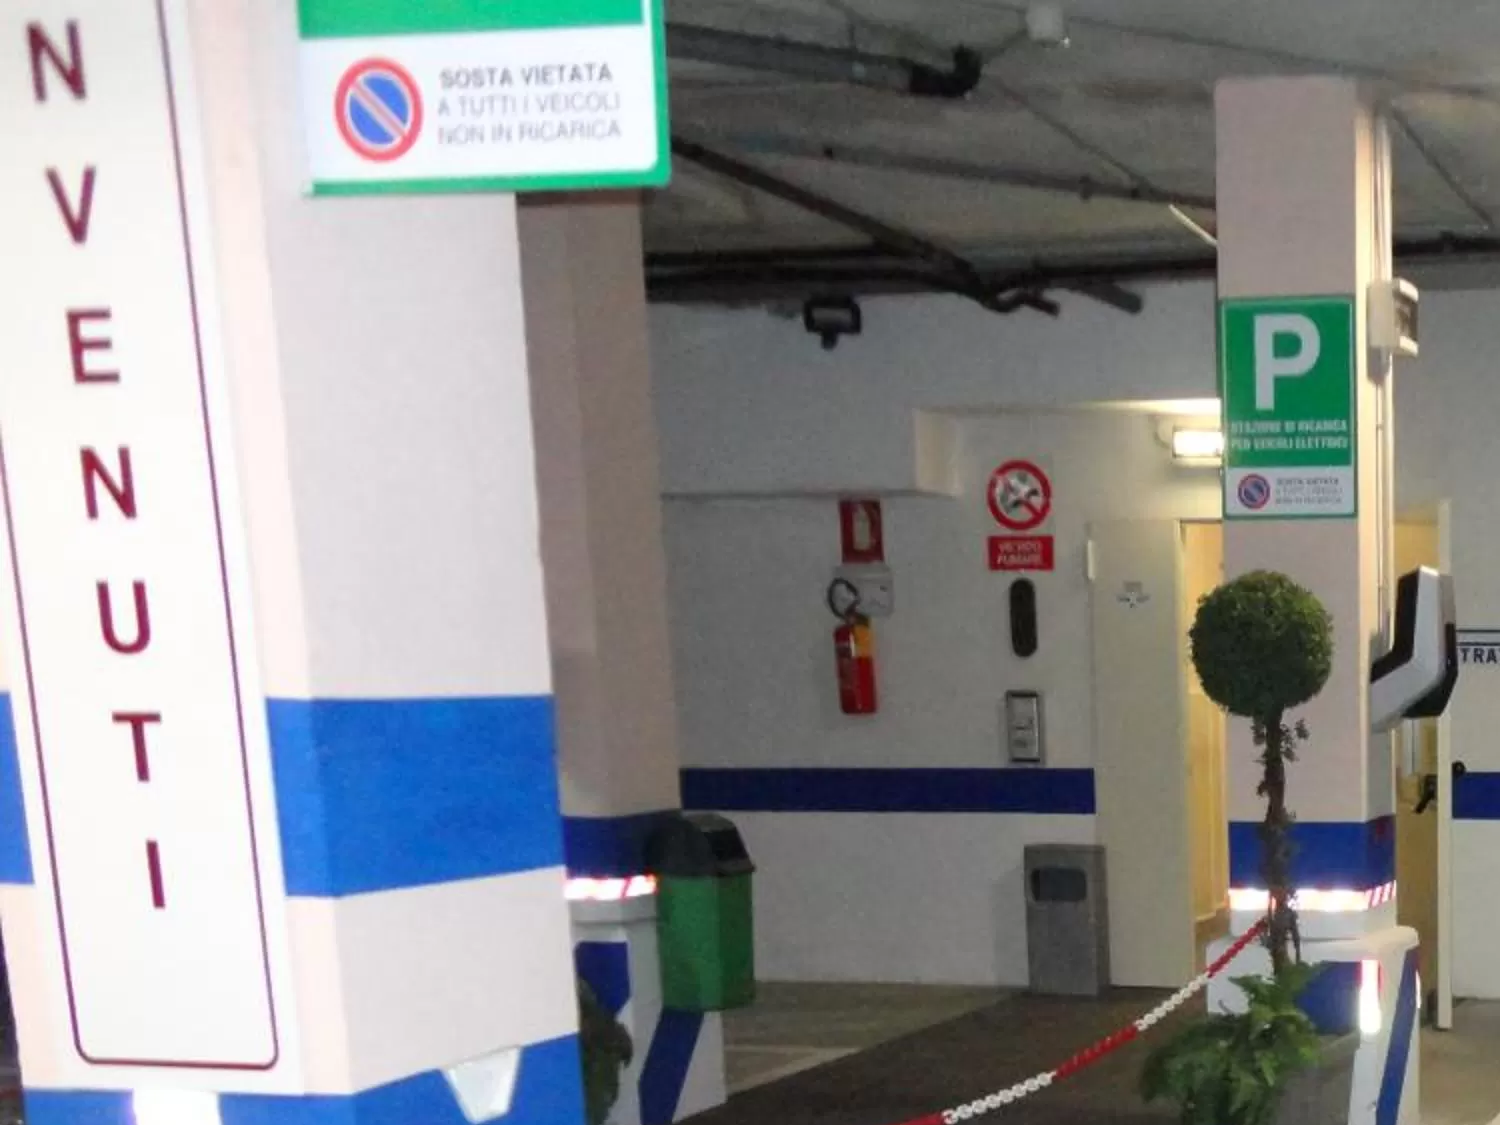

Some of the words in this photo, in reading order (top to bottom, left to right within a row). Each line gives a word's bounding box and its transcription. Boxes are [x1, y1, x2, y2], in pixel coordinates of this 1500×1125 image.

[438, 66, 514, 90] SOSTA
[519, 62, 614, 87] VIETATA
[437, 96, 450, 117] A
[457, 94, 517, 118] TUTTI
[534, 91, 621, 114] VEICOLI
[437, 123, 486, 145] NON
[490, 122, 513, 144] IN
[518, 119, 622, 143] RICARICA
[1254, 313, 1321, 411] P
[27, 19, 167, 910] NVENUTI
